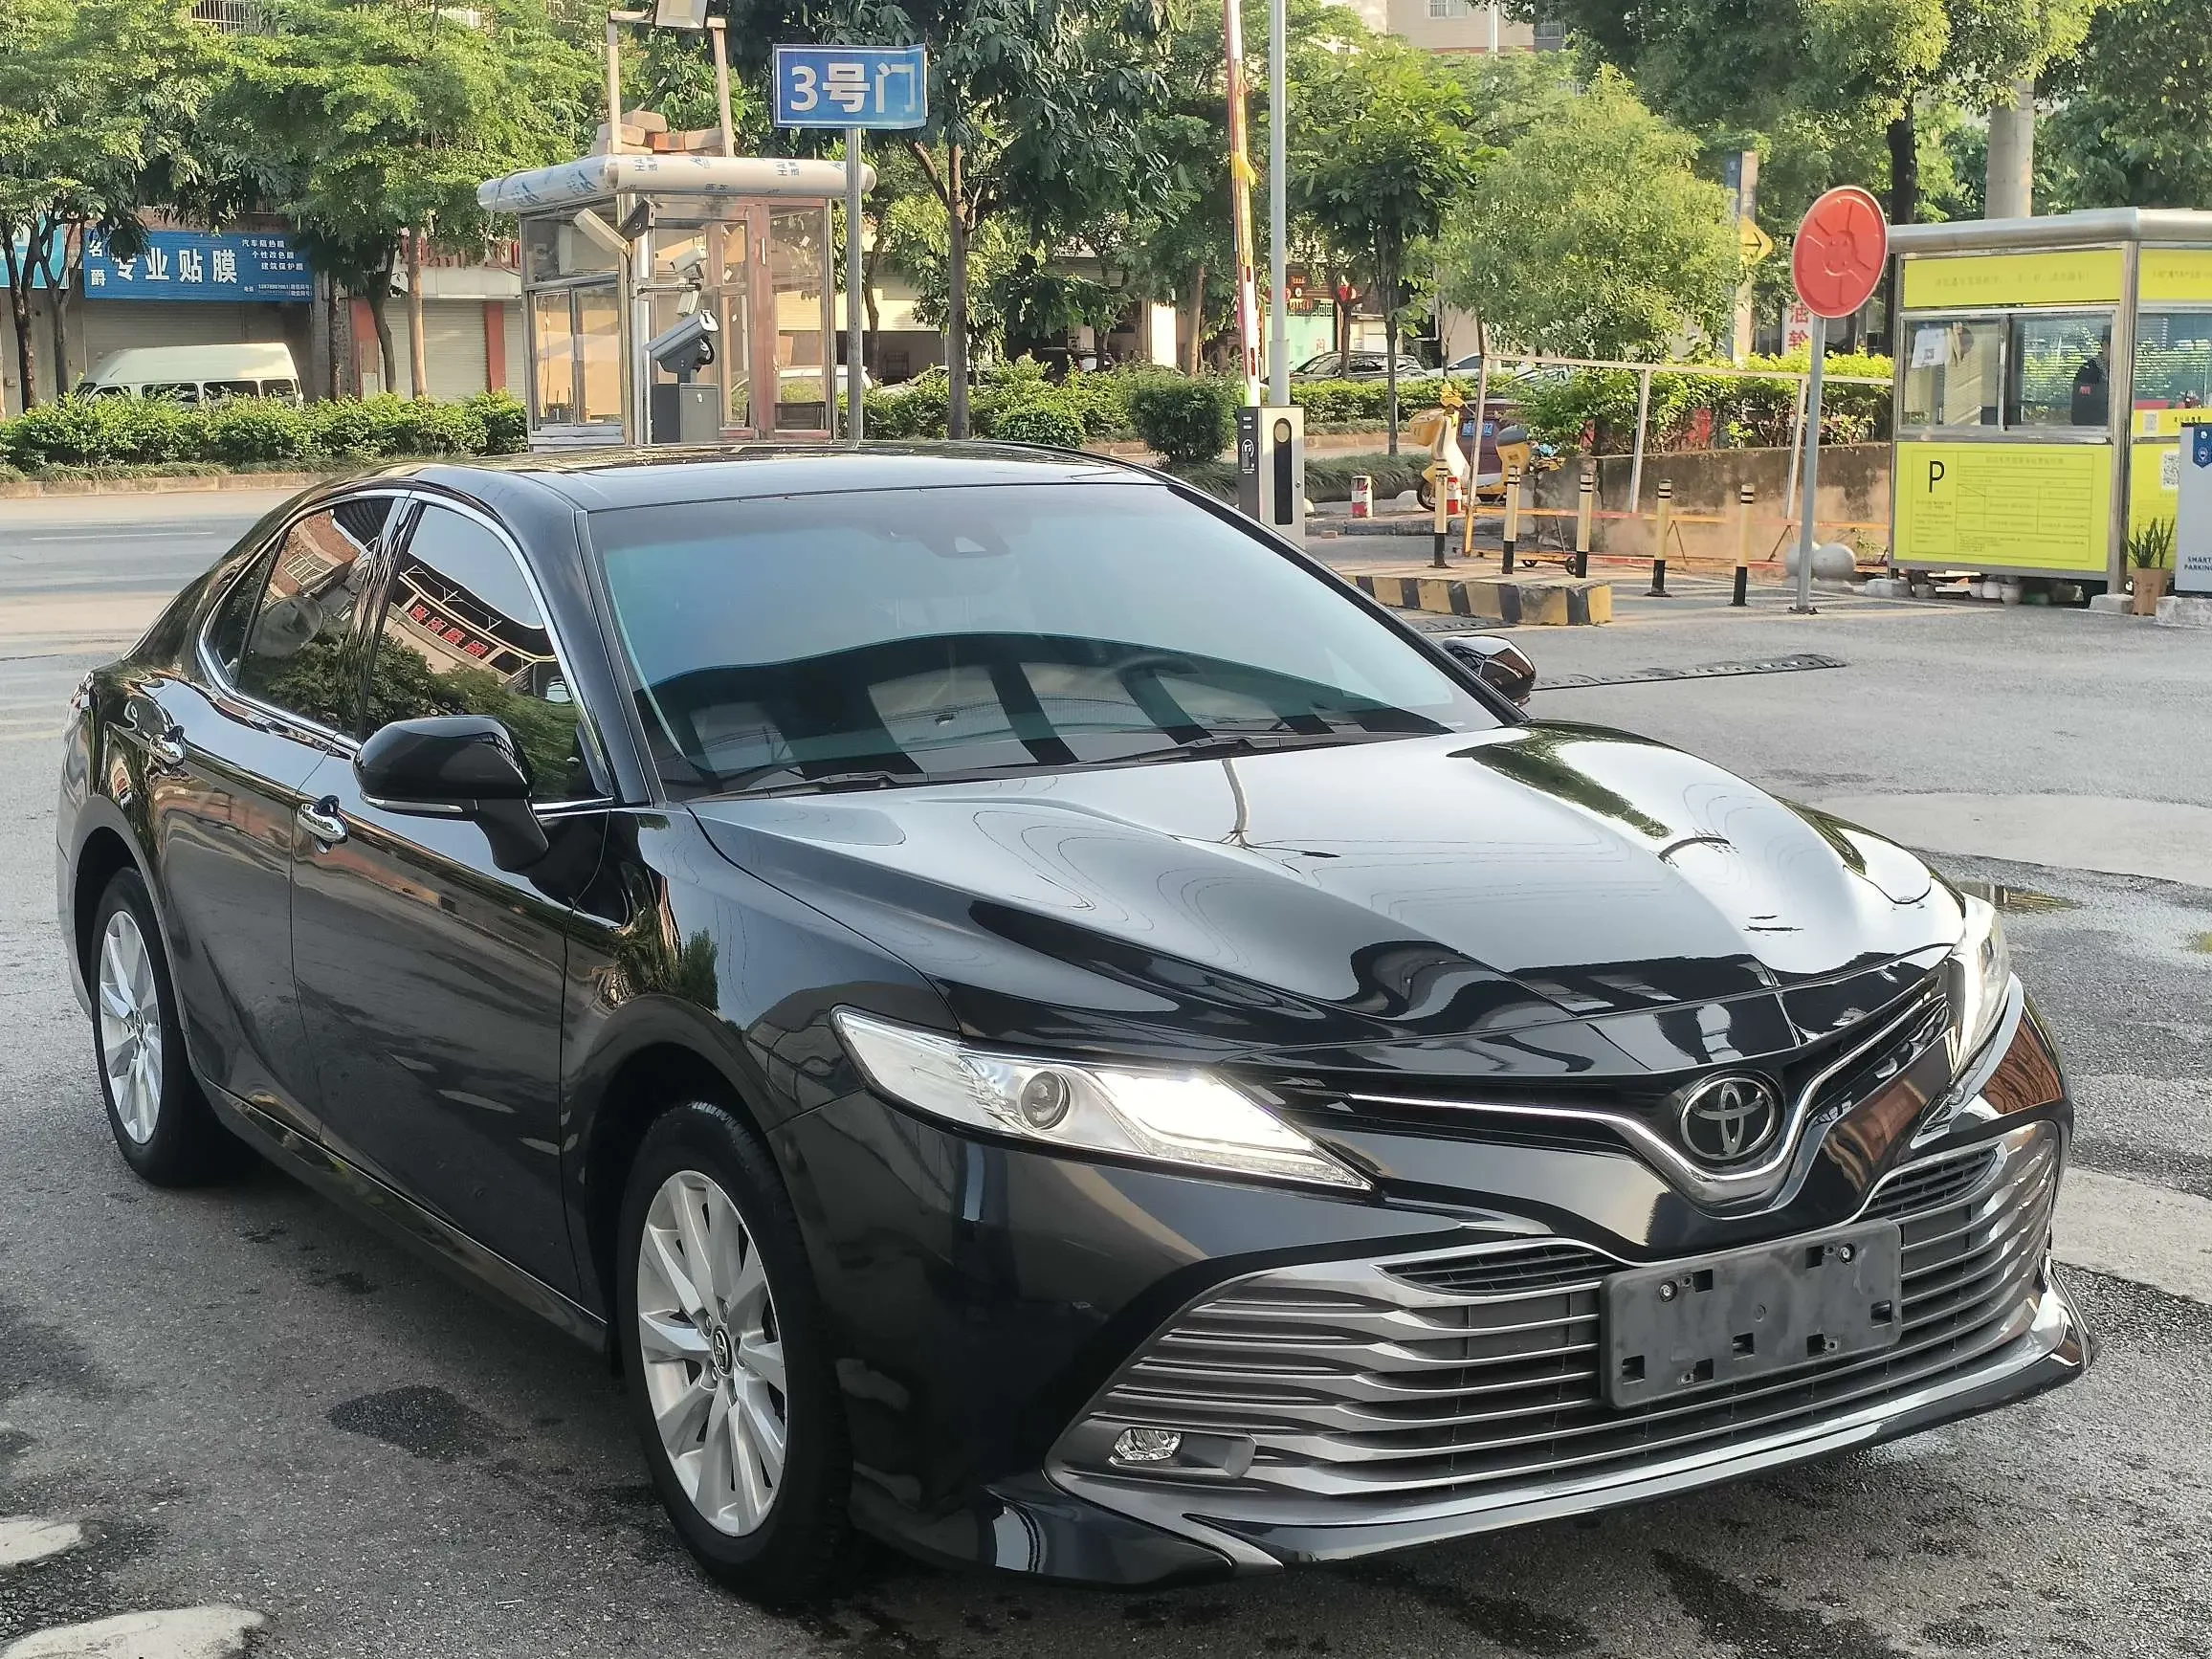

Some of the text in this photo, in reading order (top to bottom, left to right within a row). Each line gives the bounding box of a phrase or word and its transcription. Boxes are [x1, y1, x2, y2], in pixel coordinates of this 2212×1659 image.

[790, 62, 916, 113] 3号门
[89, 240, 106, 286] 名爵
[112, 247, 237, 283] 专业贴膜
[252, 251, 295, 259] 个性改色膜
[1929, 460, 1945, 493] P
